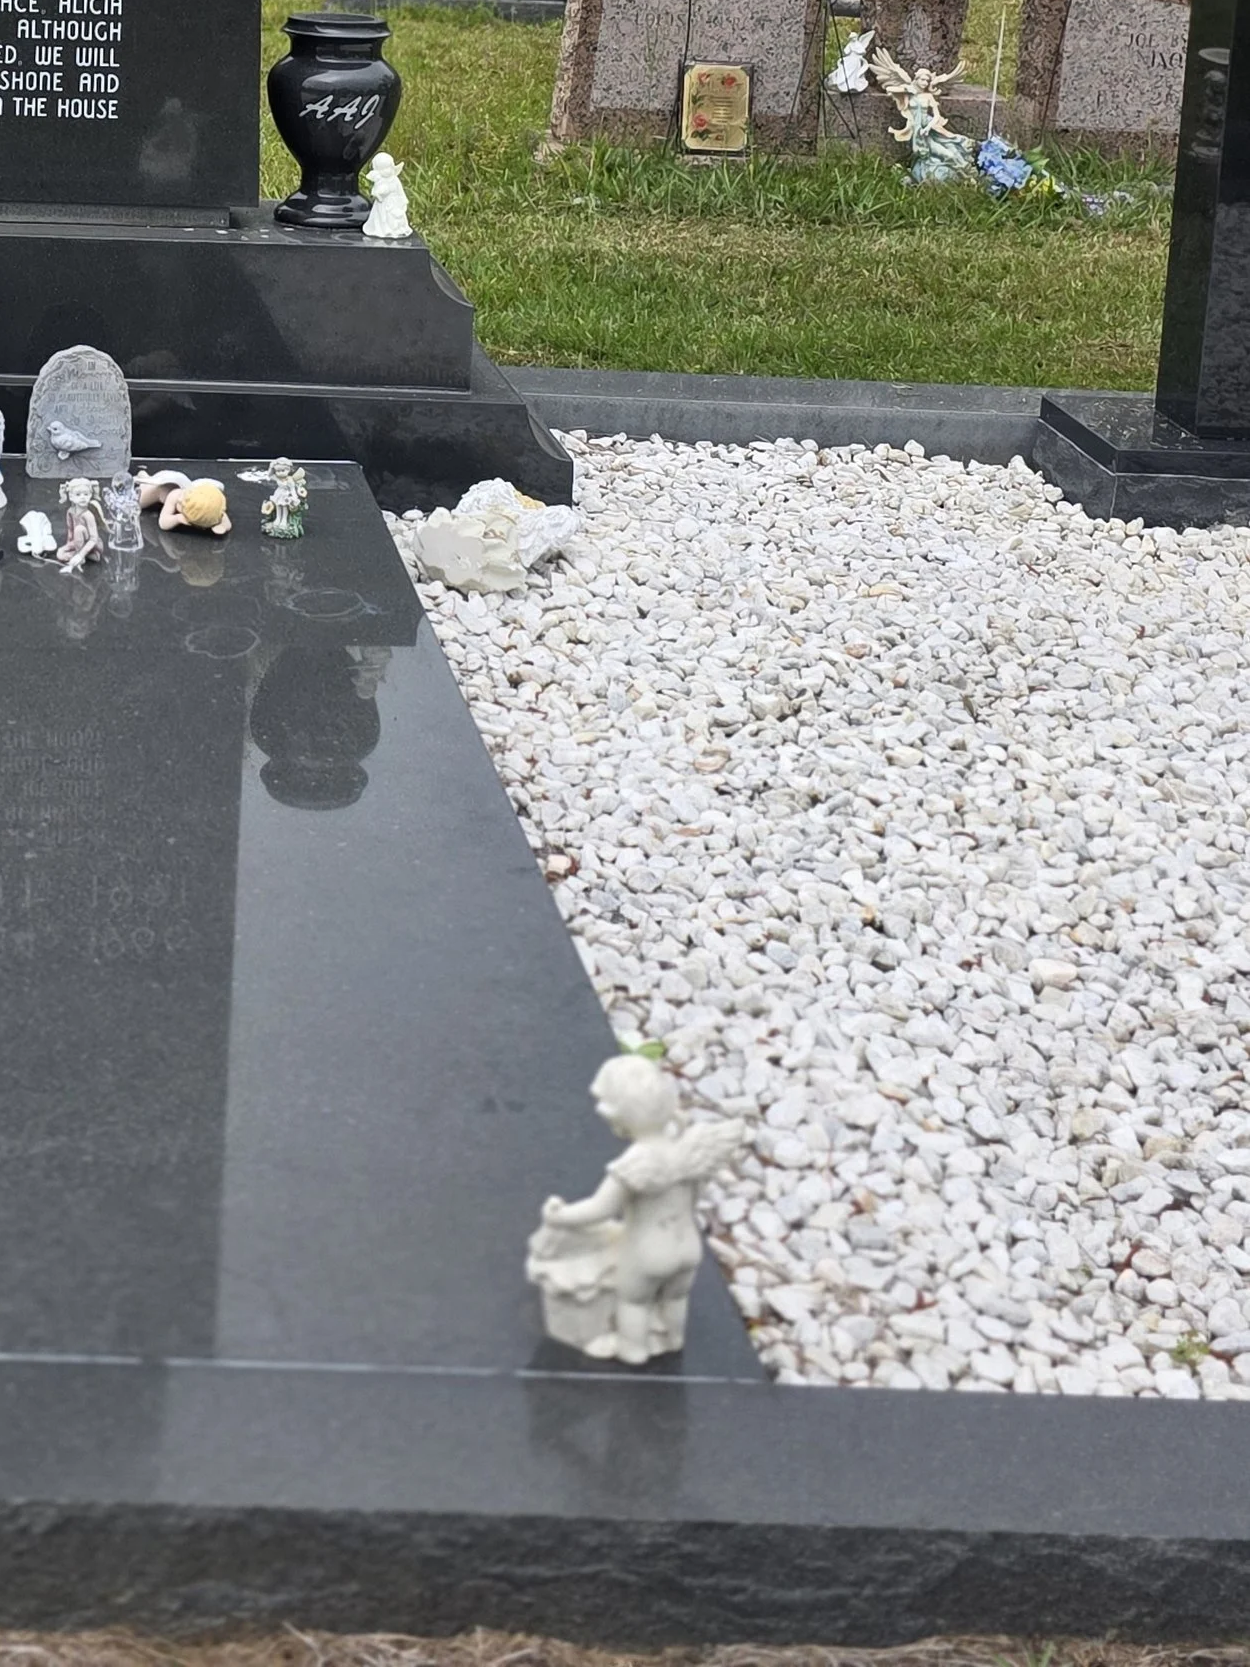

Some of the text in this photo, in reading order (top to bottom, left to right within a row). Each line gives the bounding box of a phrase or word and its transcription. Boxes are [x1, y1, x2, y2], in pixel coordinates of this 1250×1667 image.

[17, 18, 122, 42] ALTHOUGH
[34, 45, 64, 66] WE
[75, 46, 121, 68] WILL
[78, 72, 120, 93] AND
[12, 96, 48, 117] THE
[57, 98, 119, 119] HOUSE
